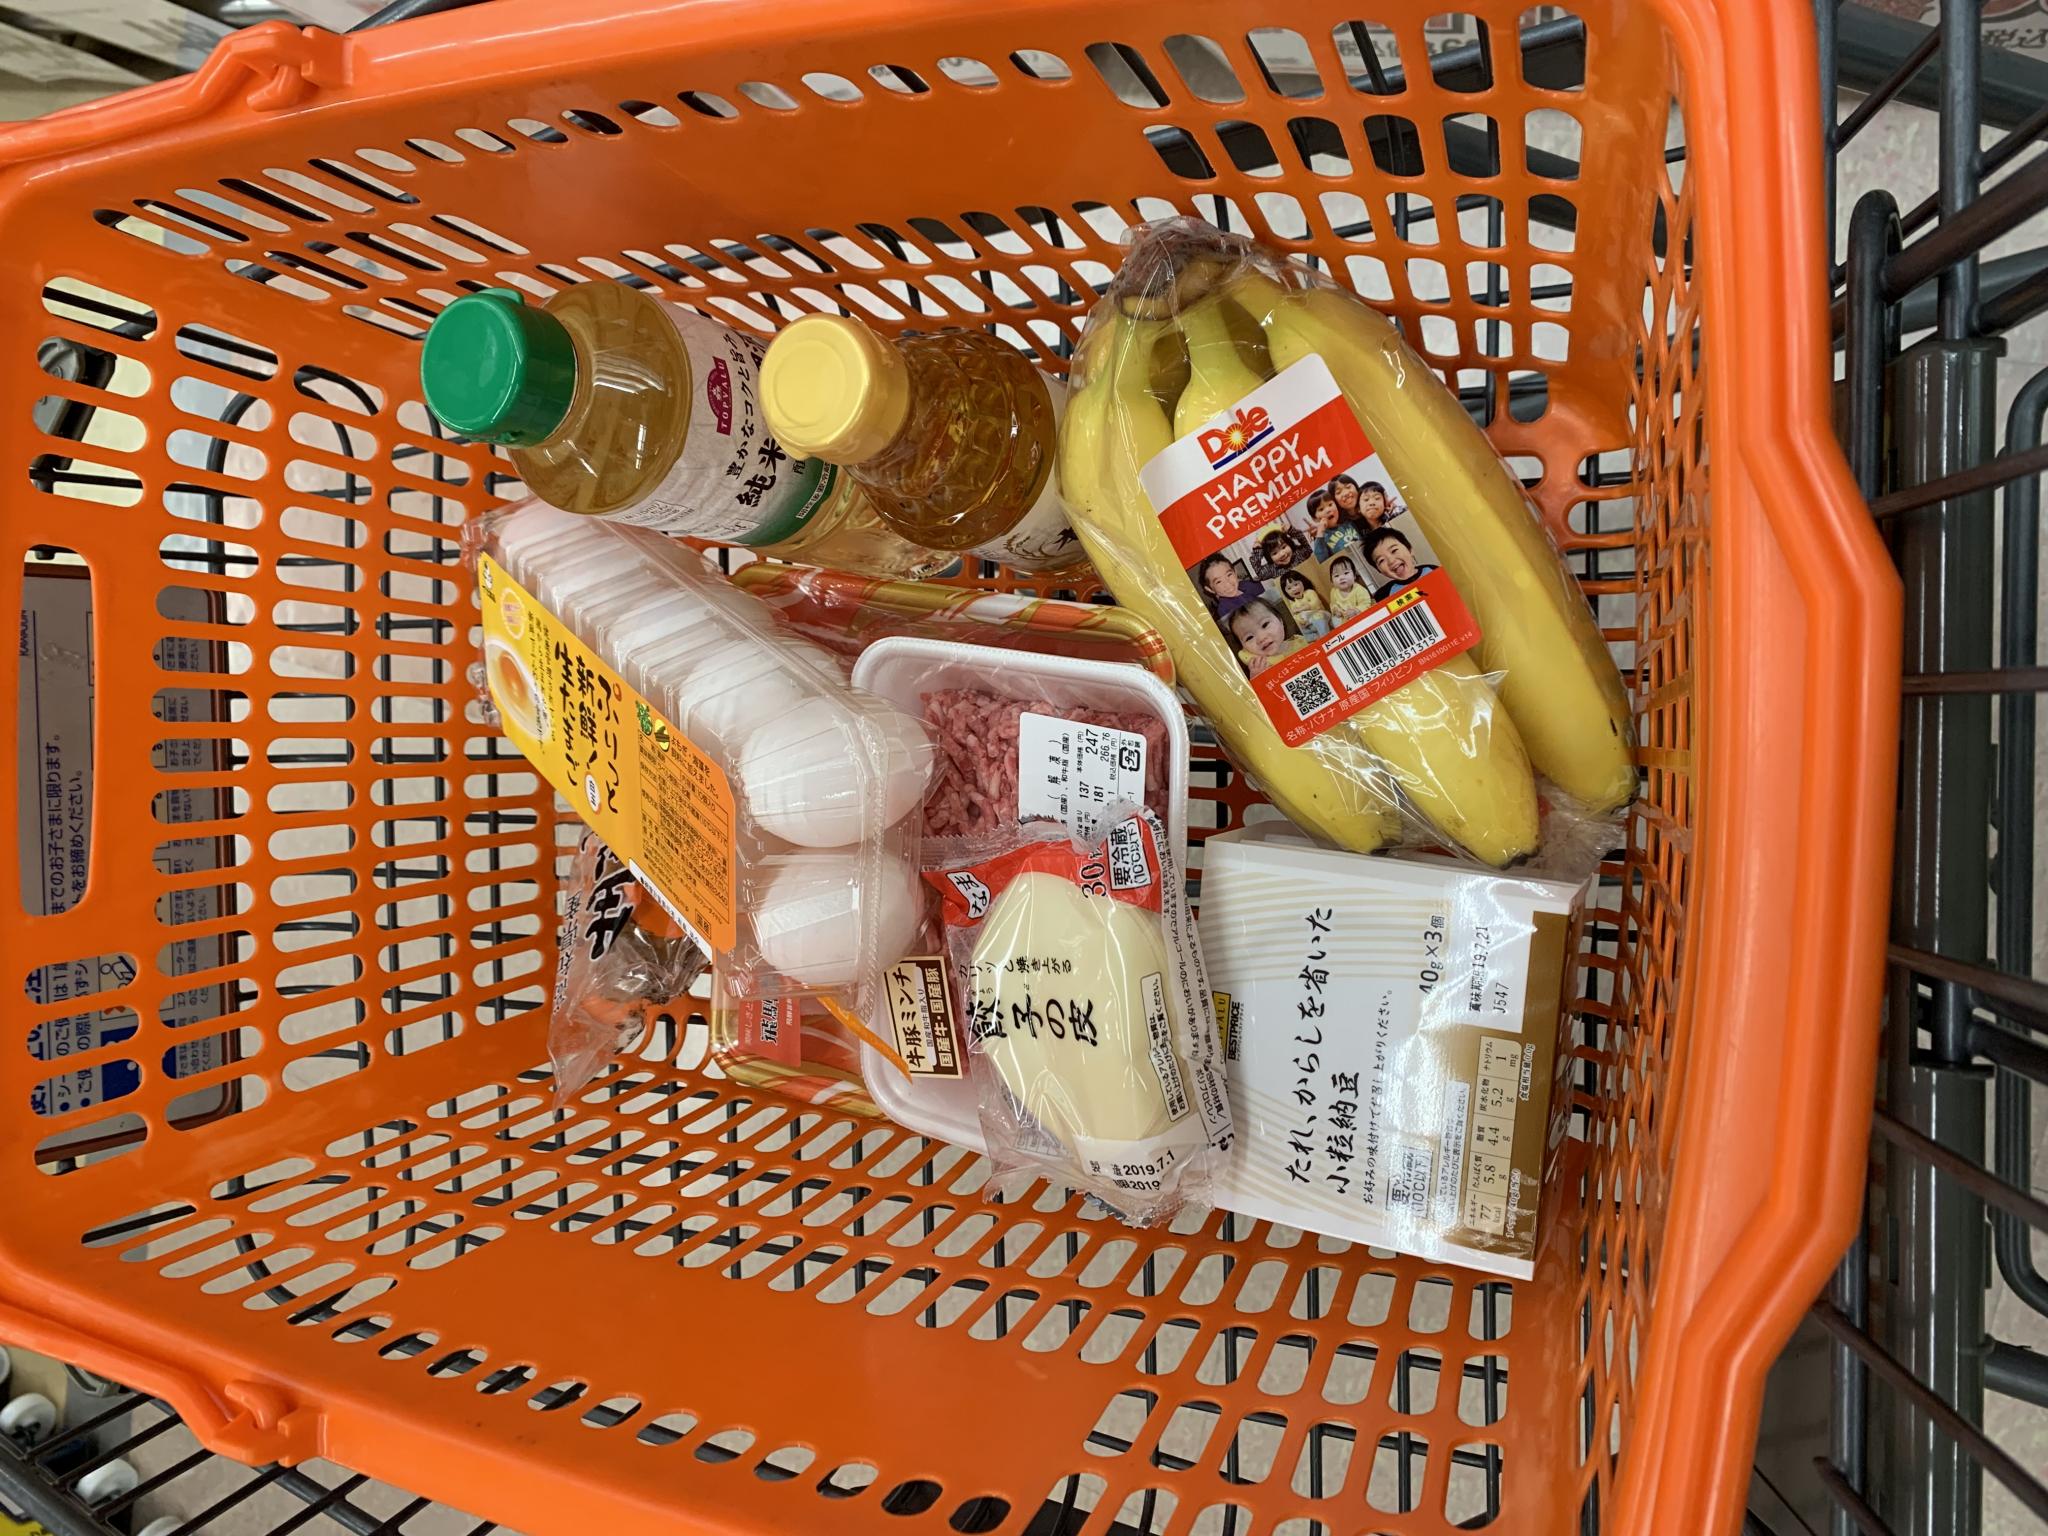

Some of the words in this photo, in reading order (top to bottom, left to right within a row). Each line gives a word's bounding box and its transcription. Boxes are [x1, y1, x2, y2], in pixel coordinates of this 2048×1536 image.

[717, 360, 731, 430] TOPVALU
[1197, 407, 1271, 464] Dole
[1203, 433, 1299, 513] HAPPY
[1206, 446, 1333, 540] PREMIUM
[1357, 660, 1396, 685] 935850
[1398, 636, 1436, 662] 351315
[598, 673, 621, 814] ぷりっと
[1086, 729, 1098, 755] 247
[1100, 732, 1110, 762] 266.76
[1080, 781, 1090, 799] 137
[1094, 785, 1104, 803] 181
[1111, 827, 1131, 886] 要冷蔵
[955, 874, 988, 914] なま
[1493, 982, 1510, 1013] J547
[892, 967, 922, 1068] 牛豚ミンチ
[925, 966, 953, 1067] 国産牛・国産豚
[966, 994, 1098, 1047] 餃子の皮
[1227, 1001, 1240, 1061] BESTPRICE
[1284, 907, 1333, 1184] たれ、からしを省いた
[1484, 1041, 1493, 1070] ナトリウム
[1510, 1054, 1519, 1067] mg
[1480, 1079, 1489, 1111] 炭水化物
[1492, 1089, 1503, 1107] 5.2
[1326, 1072, 1360, 1194] 小粒納豆
[1477, 1126, 1485, 1141] 脂質
[1489, 1127, 1499, 1146] 4.4
[1472, 1156, 1482, 1188] たんぱく質
[1484, 1166, 1495, 1184] 5.8
[1480, 1205, 1489, 1220] 77
